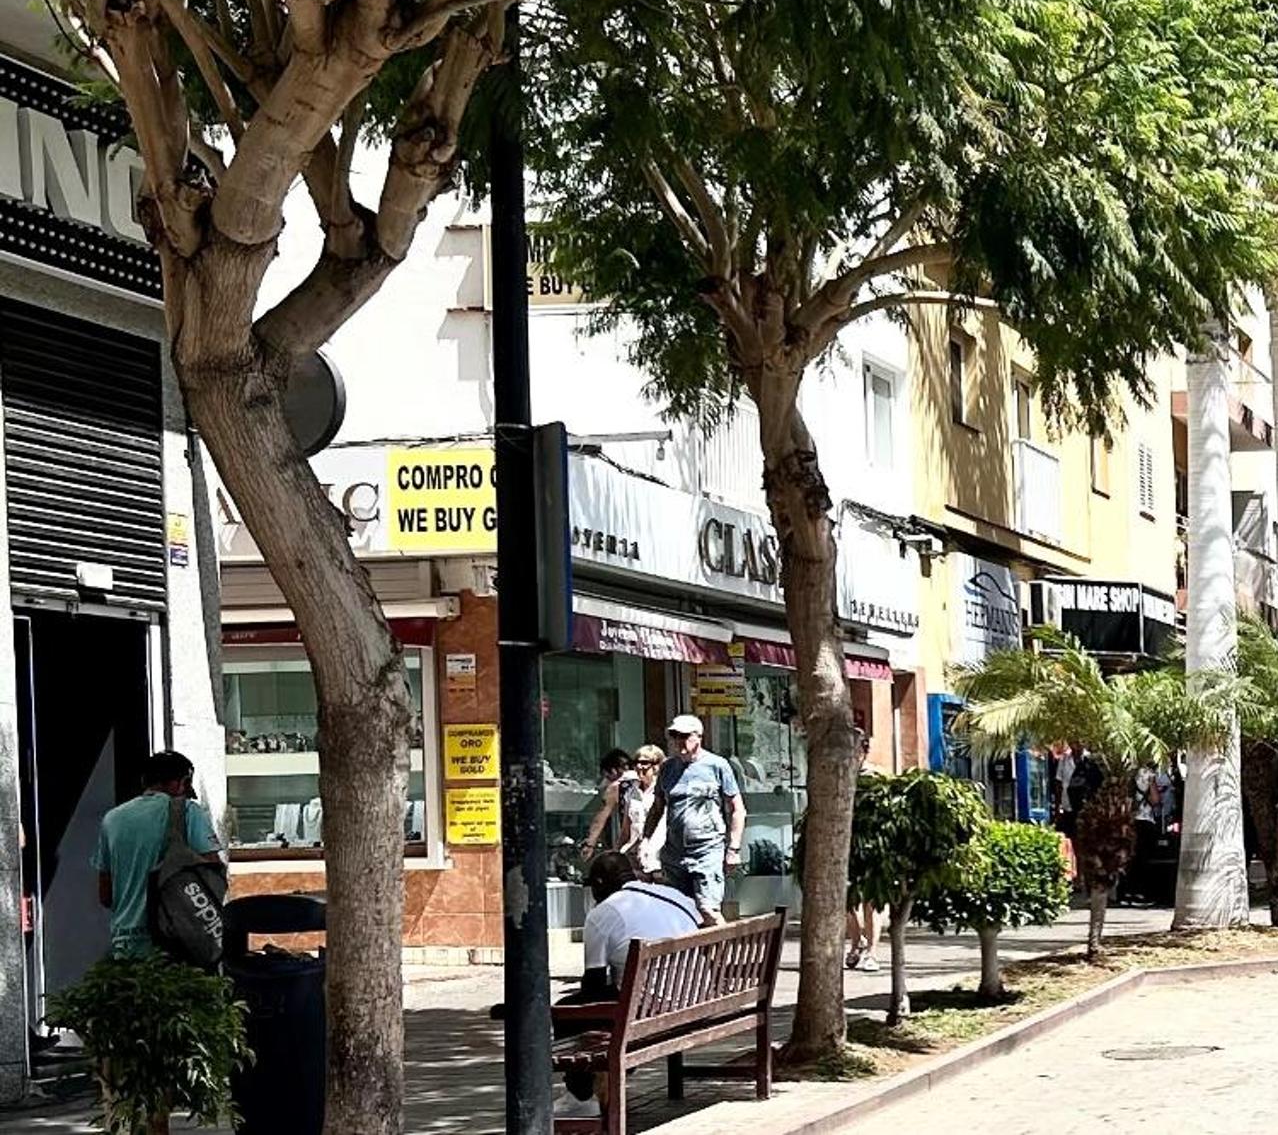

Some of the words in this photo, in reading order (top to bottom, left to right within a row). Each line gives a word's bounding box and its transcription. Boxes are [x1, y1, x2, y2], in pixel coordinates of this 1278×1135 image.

[397, 464, 483, 490] COMPRO
[397, 508, 428, 532] WE
[434, 507, 476, 532] BUY
[460, 739, 482, 748] ORO
[451, 756, 467, 764] WE
[470, 755, 491, 764] BUY
[460, 765, 484, 774] GOLD
